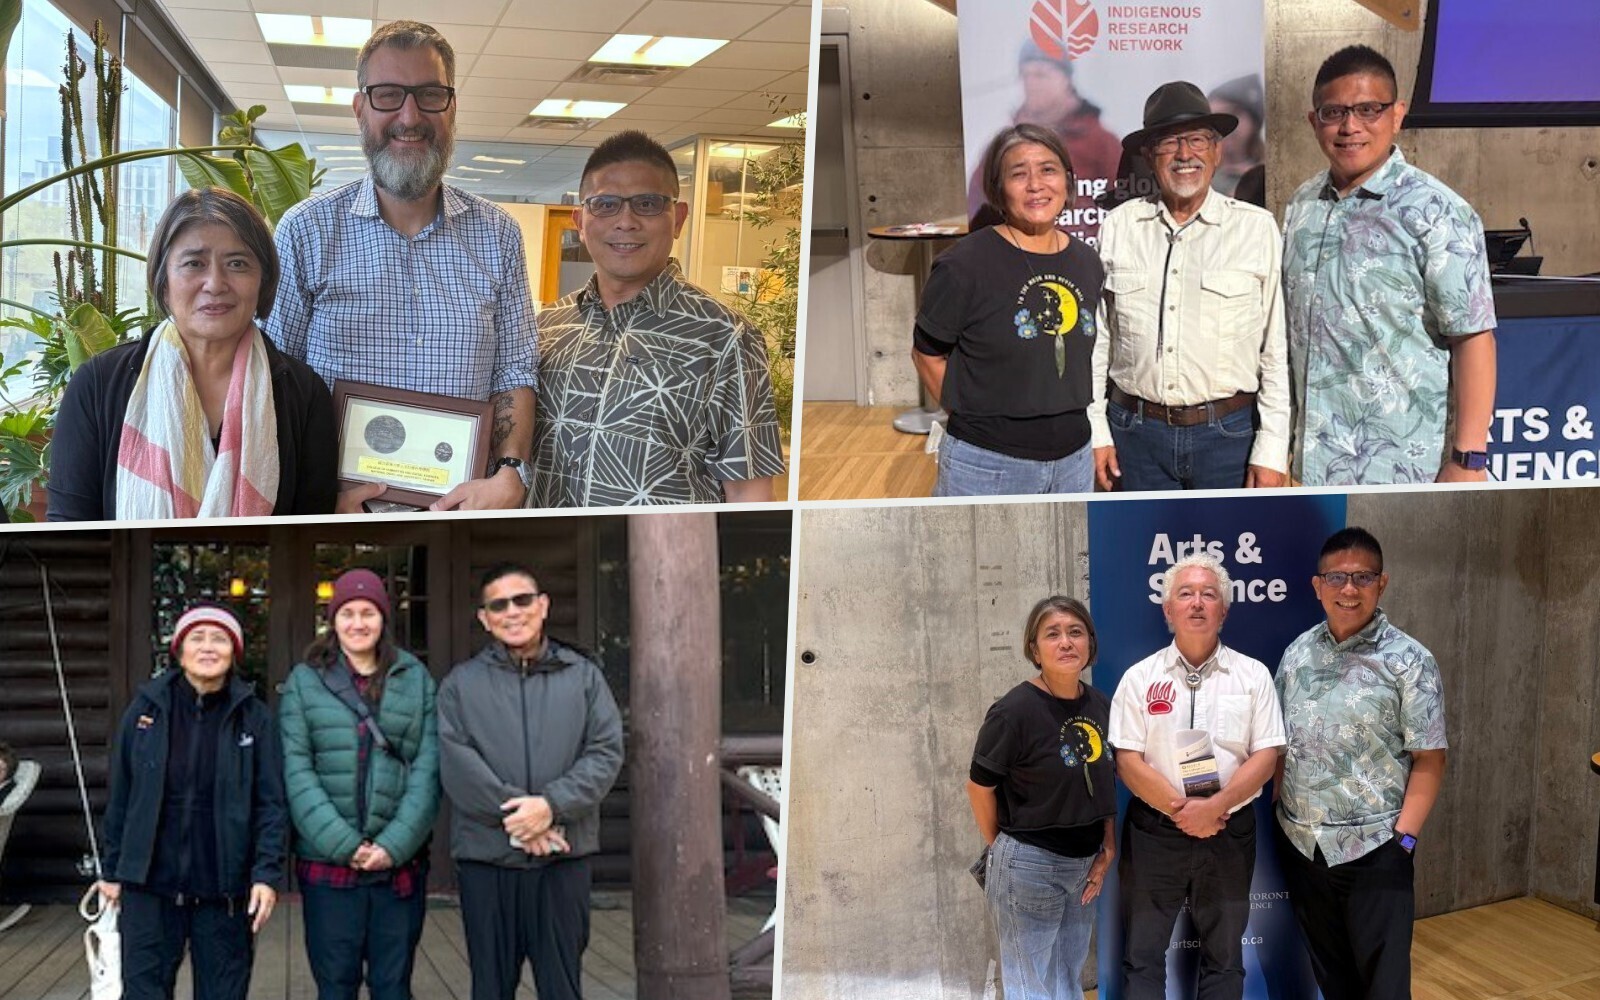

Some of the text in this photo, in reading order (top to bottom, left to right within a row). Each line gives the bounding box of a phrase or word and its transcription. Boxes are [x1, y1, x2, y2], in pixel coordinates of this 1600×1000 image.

[1108, 6, 1201, 18] INDIGENOUS
[1108, 23, 1188, 34] RESEARCH
[1109, 40, 1183, 51] NETWORK
[1562, 405, 1594, 440] &
[1148, 532, 1263, 565] Arts &
[1148, 572, 1287, 604] Snce
[1250, 902, 1273, 910] ENCE
